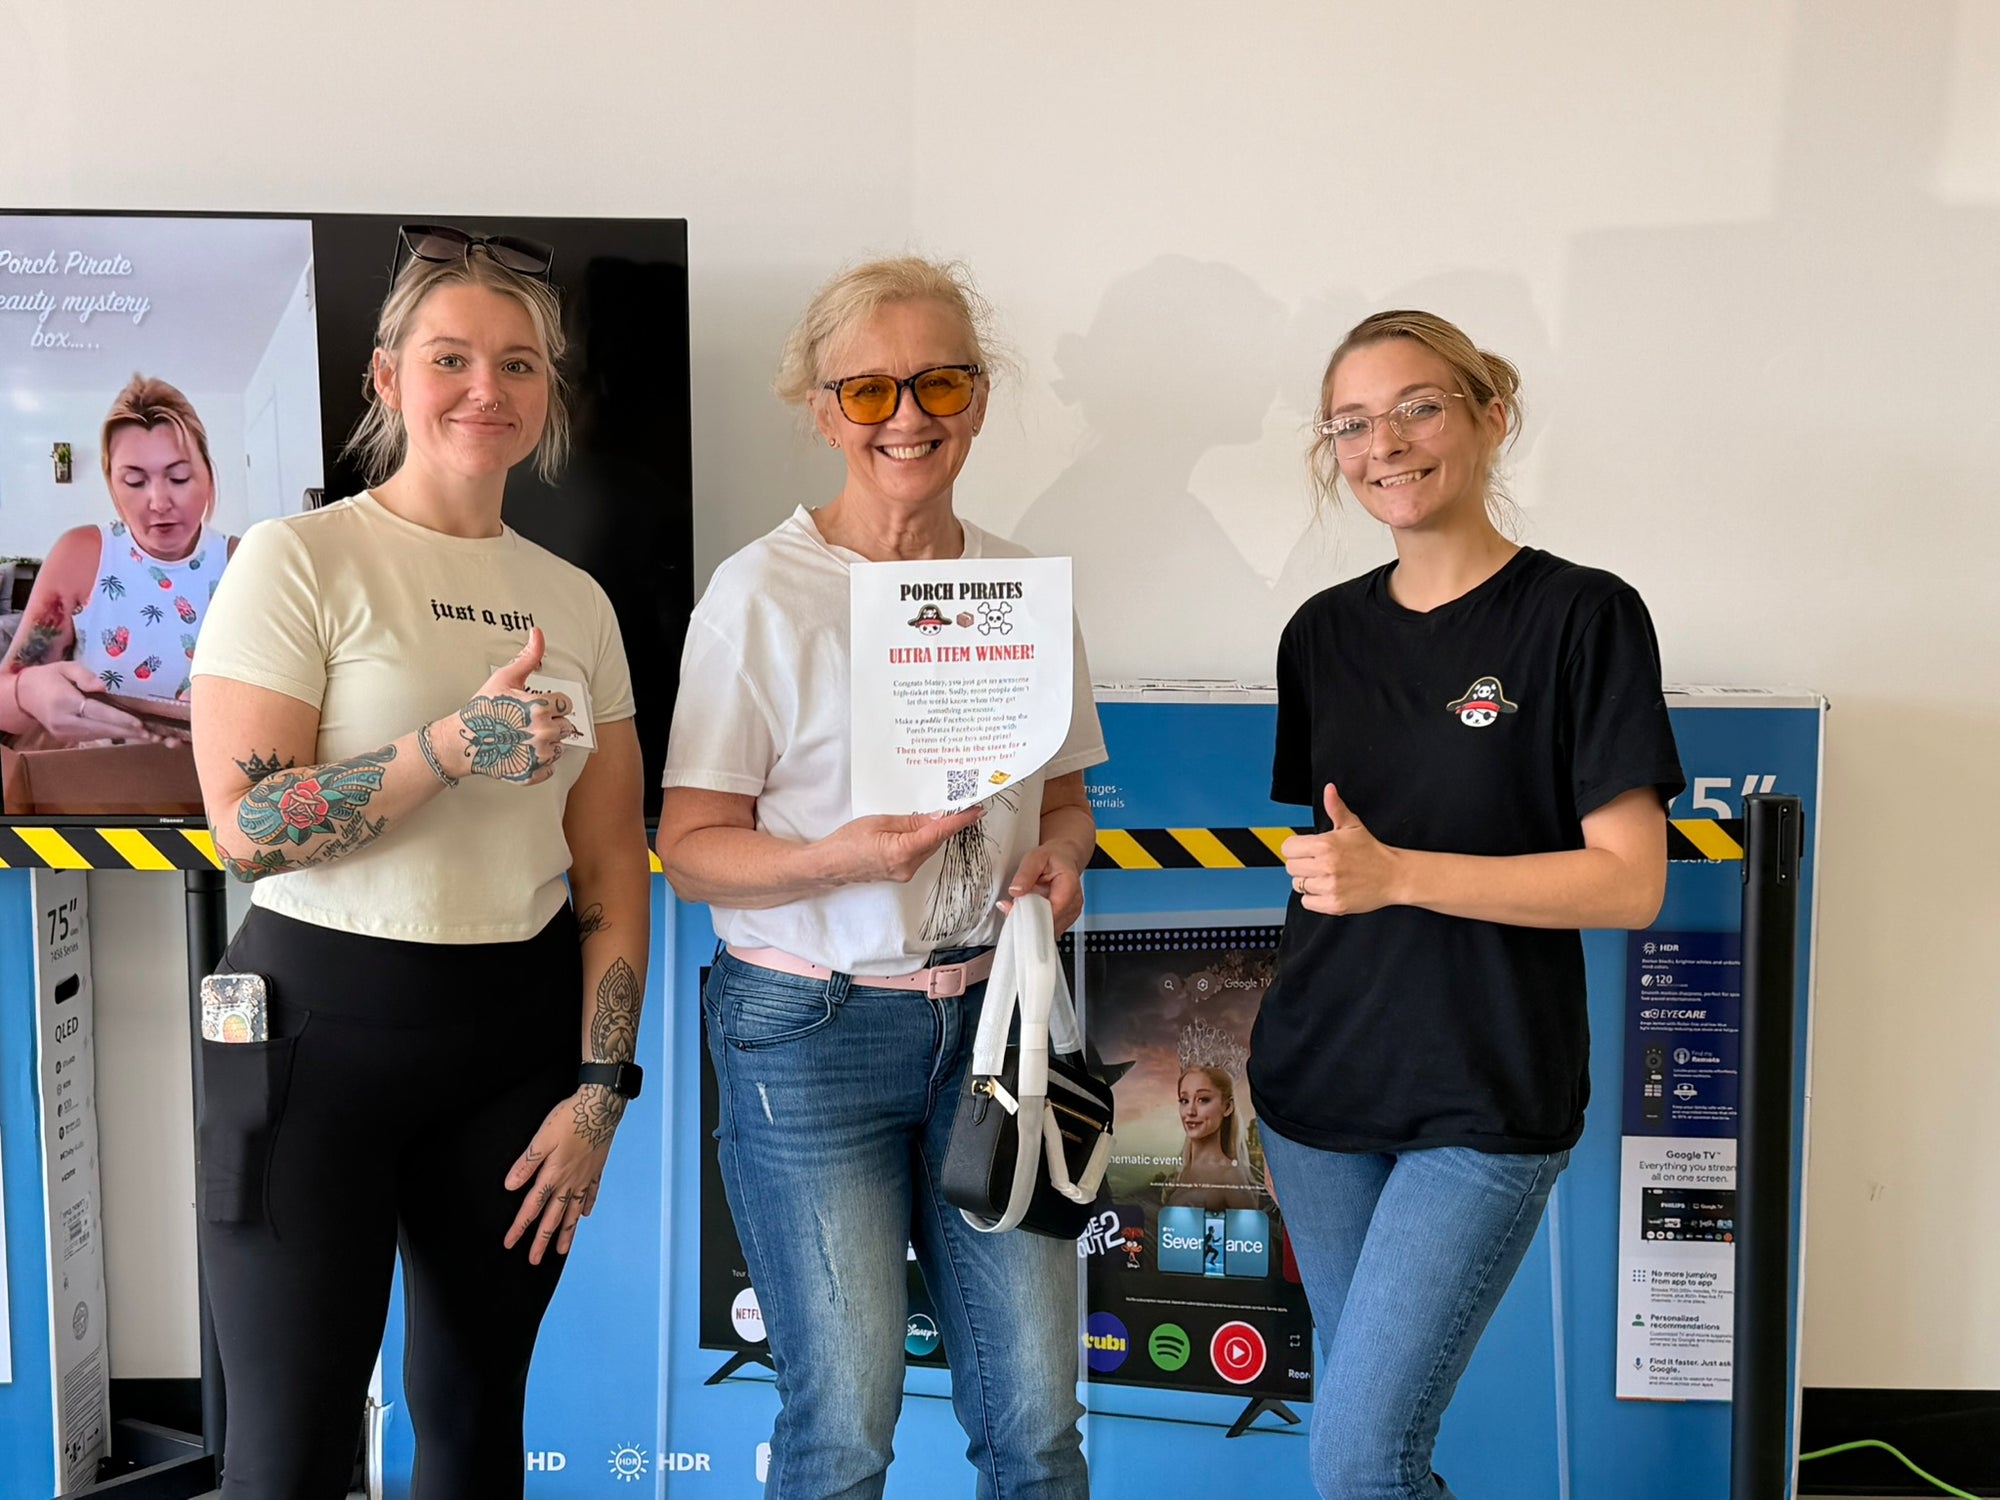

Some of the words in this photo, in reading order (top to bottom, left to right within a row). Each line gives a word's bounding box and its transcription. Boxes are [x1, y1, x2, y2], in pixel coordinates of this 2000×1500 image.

[0, 249, 59, 275] Porch
[64, 250, 132, 275] Pirate
[0, 289, 56, 323] eauty
[62, 291, 150, 324] mystery
[900, 583, 954, 601] PORCH
[959, 582, 1023, 600] PIRATES
[431, 599, 476, 622] just
[482, 609, 496, 626] a
[501, 611, 534, 631] girl
[889, 647, 932, 664] ULTRA
[937, 646, 971, 663] ITEM
[975, 644, 1035, 661] WINNER!
[929, 697, 948, 705] world
[895, 717, 913, 725] Make
[943, 716, 975, 724] Facebook
[927, 726, 950, 734] Pirates
[951, 725, 983, 733] Facebook
[896, 746, 917, 755] Then
[941, 745, 961, 753] back
[973, 744, 985, 752] the
[987, 743, 1007, 751] store
[906, 757, 921, 765] free
[965, 755, 997, 763] mystery
[1085, 785, 1117, 796] mages
[1089, 797, 1125, 808] terials
[48, 898, 78, 945] 75"
[1660, 943, 1679, 952] HDR
[1224, 979, 1257, 991] Google
[1260, 978, 1272, 988] TV
[1655, 975, 1673, 984] 120
[1660, 1009, 1707, 1019] EYECARE
[55, 1016, 79, 1044] QLED
[1109, 1153, 1150, 1165] nematic
[1153, 1155, 1184, 1166] event
[1666, 1150, 1701, 1161] Google
[1639, 1161, 1687, 1172] Everything
[1689, 1163, 1706, 1172] you
[1651, 1173, 1661, 1181] all
[1696, 1175, 1728, 1183] screen.
[1100, 1210, 1126, 1249] 2
[1686, 1271, 1717, 1280] jumping
[736, 1308, 761, 1320] NETFL
[1651, 1314, 1699, 1322] Personalized
[1650, 1322, 1720, 1331] recommendations
[1082, 1332, 1126, 1351] tubi
[1649, 1357, 1667, 1365] Find
[1667, 1358, 1674, 1366] it
[1675, 1358, 1699, 1366] faster.
[1701, 1359, 1717, 1367] Just
[1718, 1359, 1731, 1367] ask
[1649, 1365, 1680, 1374] Google.
[527, 1451, 566, 1471] HD
[619, 1457, 638, 1466] HDR
[658, 1452, 711, 1471] HDR
